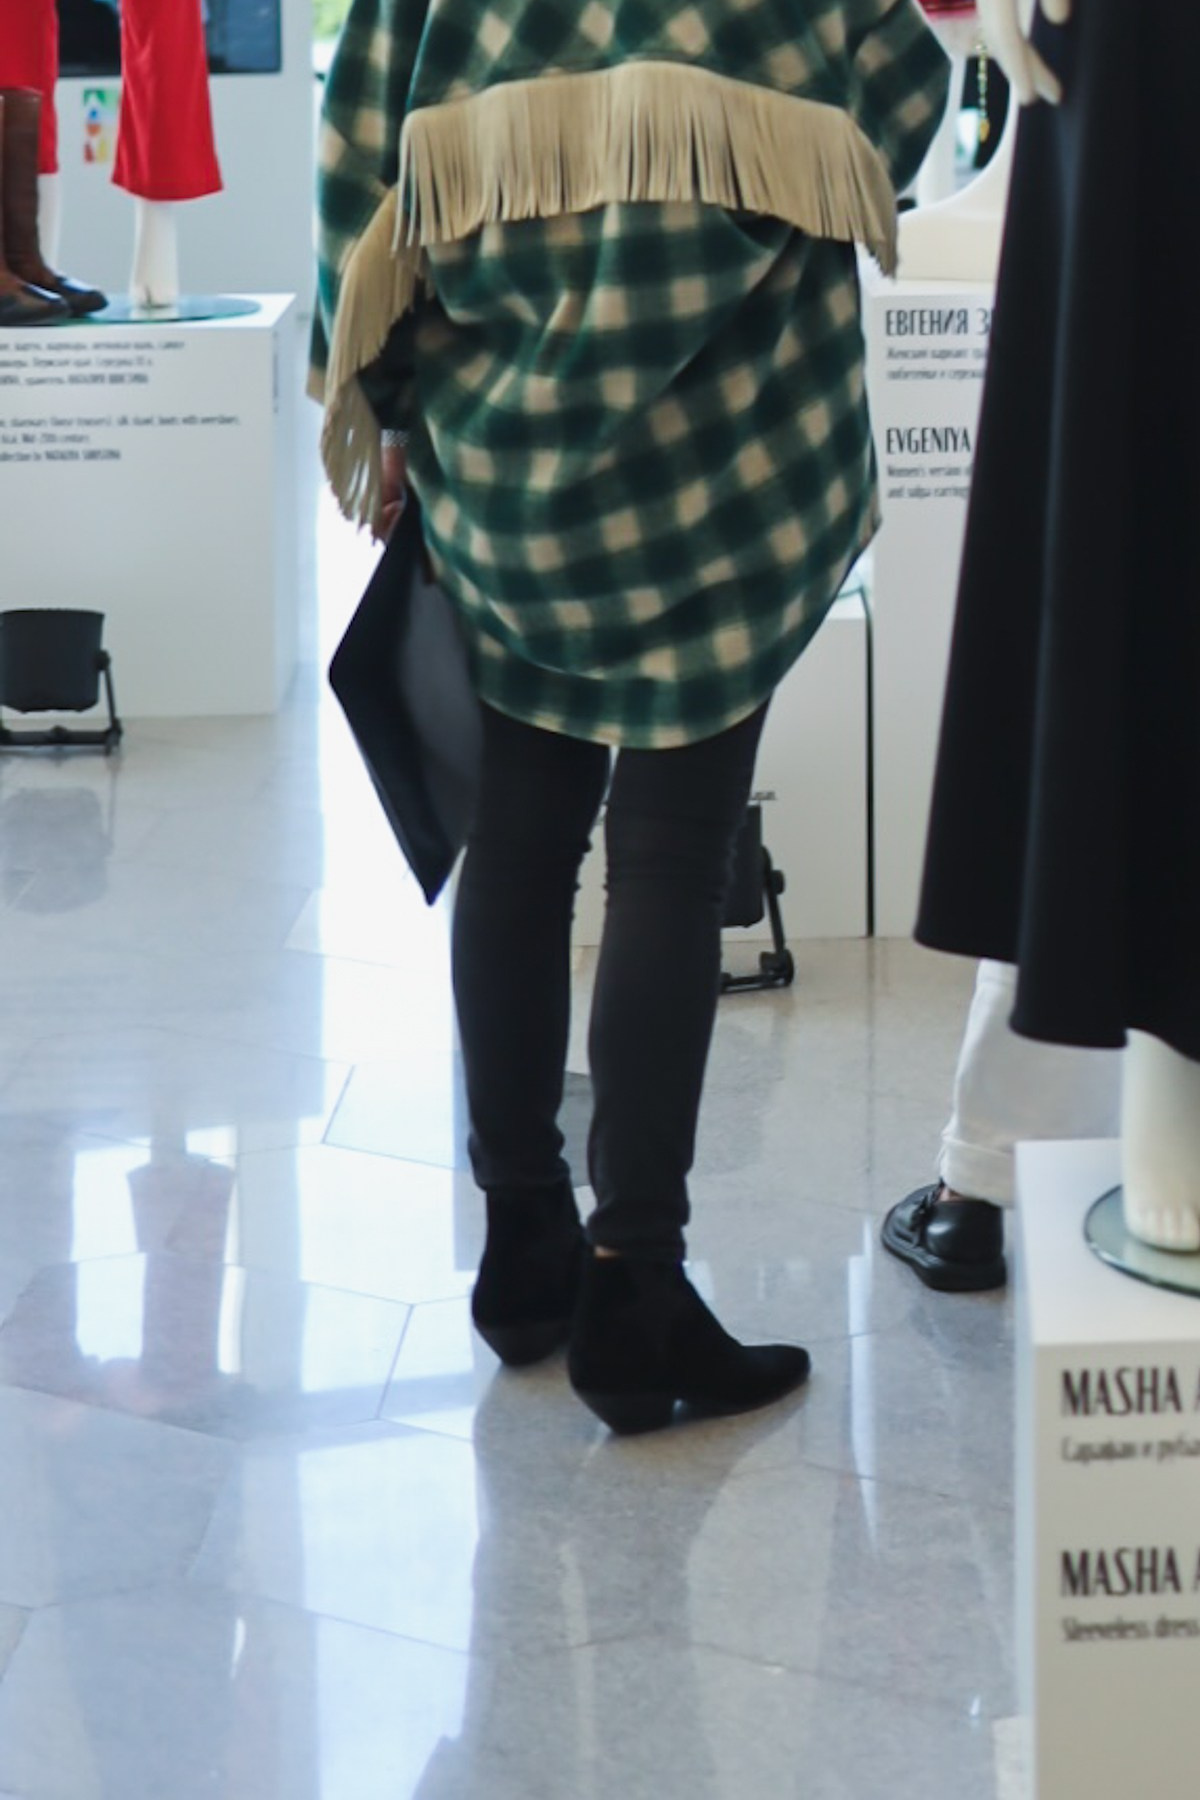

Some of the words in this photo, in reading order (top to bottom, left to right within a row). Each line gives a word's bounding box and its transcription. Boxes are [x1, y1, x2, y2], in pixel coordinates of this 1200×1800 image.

[886, 309, 968, 336] ЕВГЕНИЯ
[886, 427, 971, 454] EVGENIYA
[1062, 1368, 1182, 1416] MASHA
[1062, 1548, 1181, 1596] MASHA
